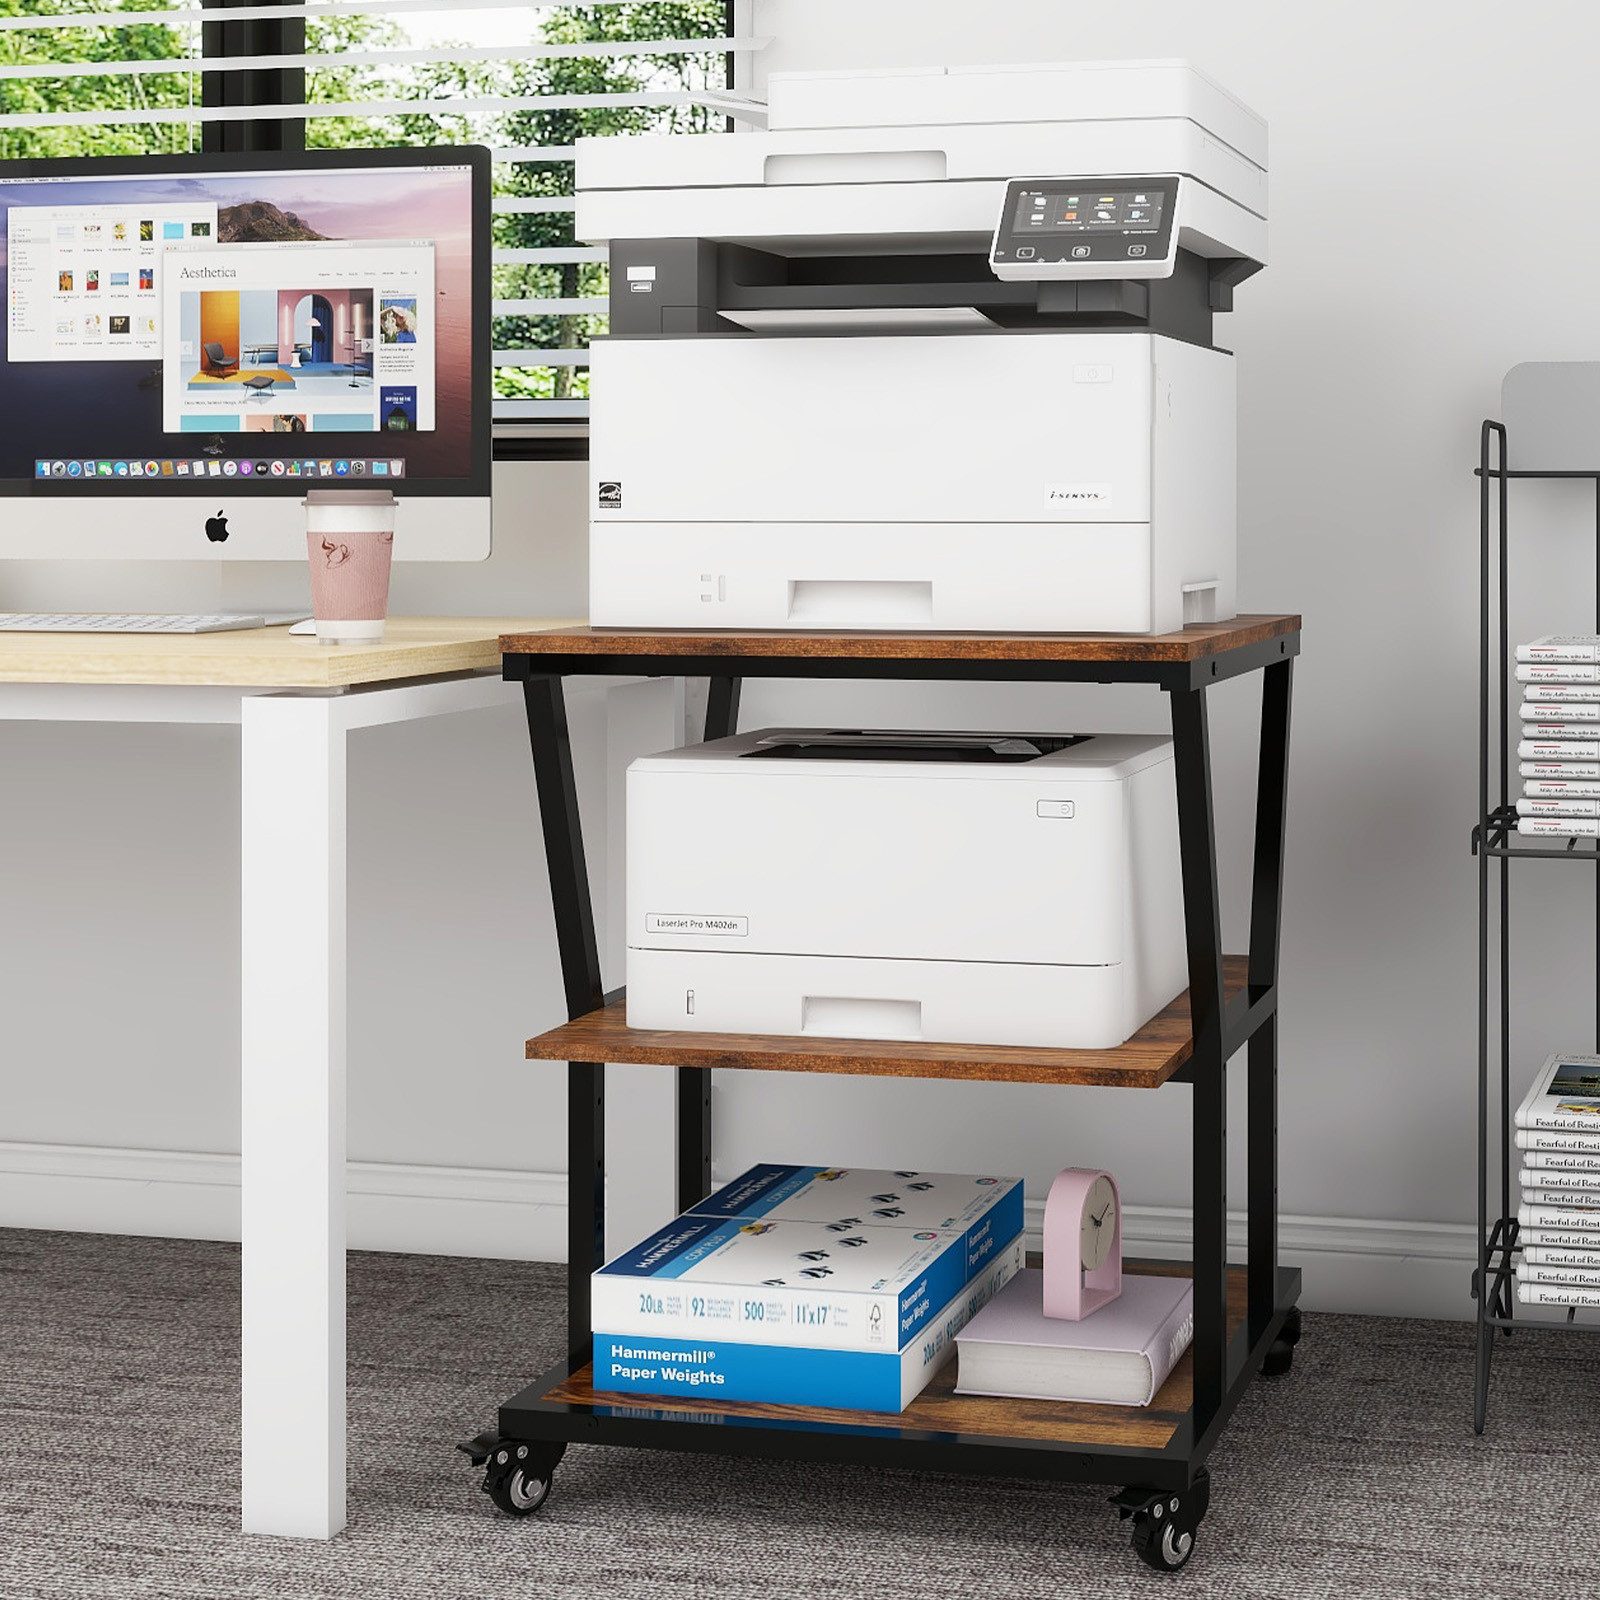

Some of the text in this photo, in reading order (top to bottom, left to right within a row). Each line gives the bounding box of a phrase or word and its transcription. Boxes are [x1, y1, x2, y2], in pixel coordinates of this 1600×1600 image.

[180, 266, 237, 279] Aesthetica
[657, 918, 737, 930] LaserJet Pro M402dn
[1536, 1118, 1566, 1127] Fearful
[1567, 1120, 1576, 1128] of
[1537, 1139, 1567, 1148] Fearful
[1568, 1141, 1577, 1149] of
[1545, 1158, 1576, 1167] Fearful
[1541, 1177, 1571, 1186] Fearful
[1572, 1179, 1581, 1187] of
[1544, 1193, 1574, 1203] Fearful
[1575, 1195, 1584, 1203] of
[1540, 1217, 1570, 1226] Fearful
[1571, 1218, 1581, 1227] of
[1541, 1234, 1571, 1243] Fearful
[1572, 1236, 1581, 1244] of
[635, 1224, 708, 1268] HAMMERMILL
[1546, 1254, 1576, 1263] Fearful
[1577, 1255, 1587, 1263] of
[1537, 1272, 1567, 1281] Fearful
[1569, 1274, 1578, 1282] of
[1540, 1294, 1570, 1303] Fearful
[1571, 1296, 1580, 1304] of
[692, 1297, 705, 1317] 92
[745, 1301, 765, 1321] 500
[611, 1344, 716, 1364] Hammermill®
[611, 1363, 725, 1386] Paper Weights
